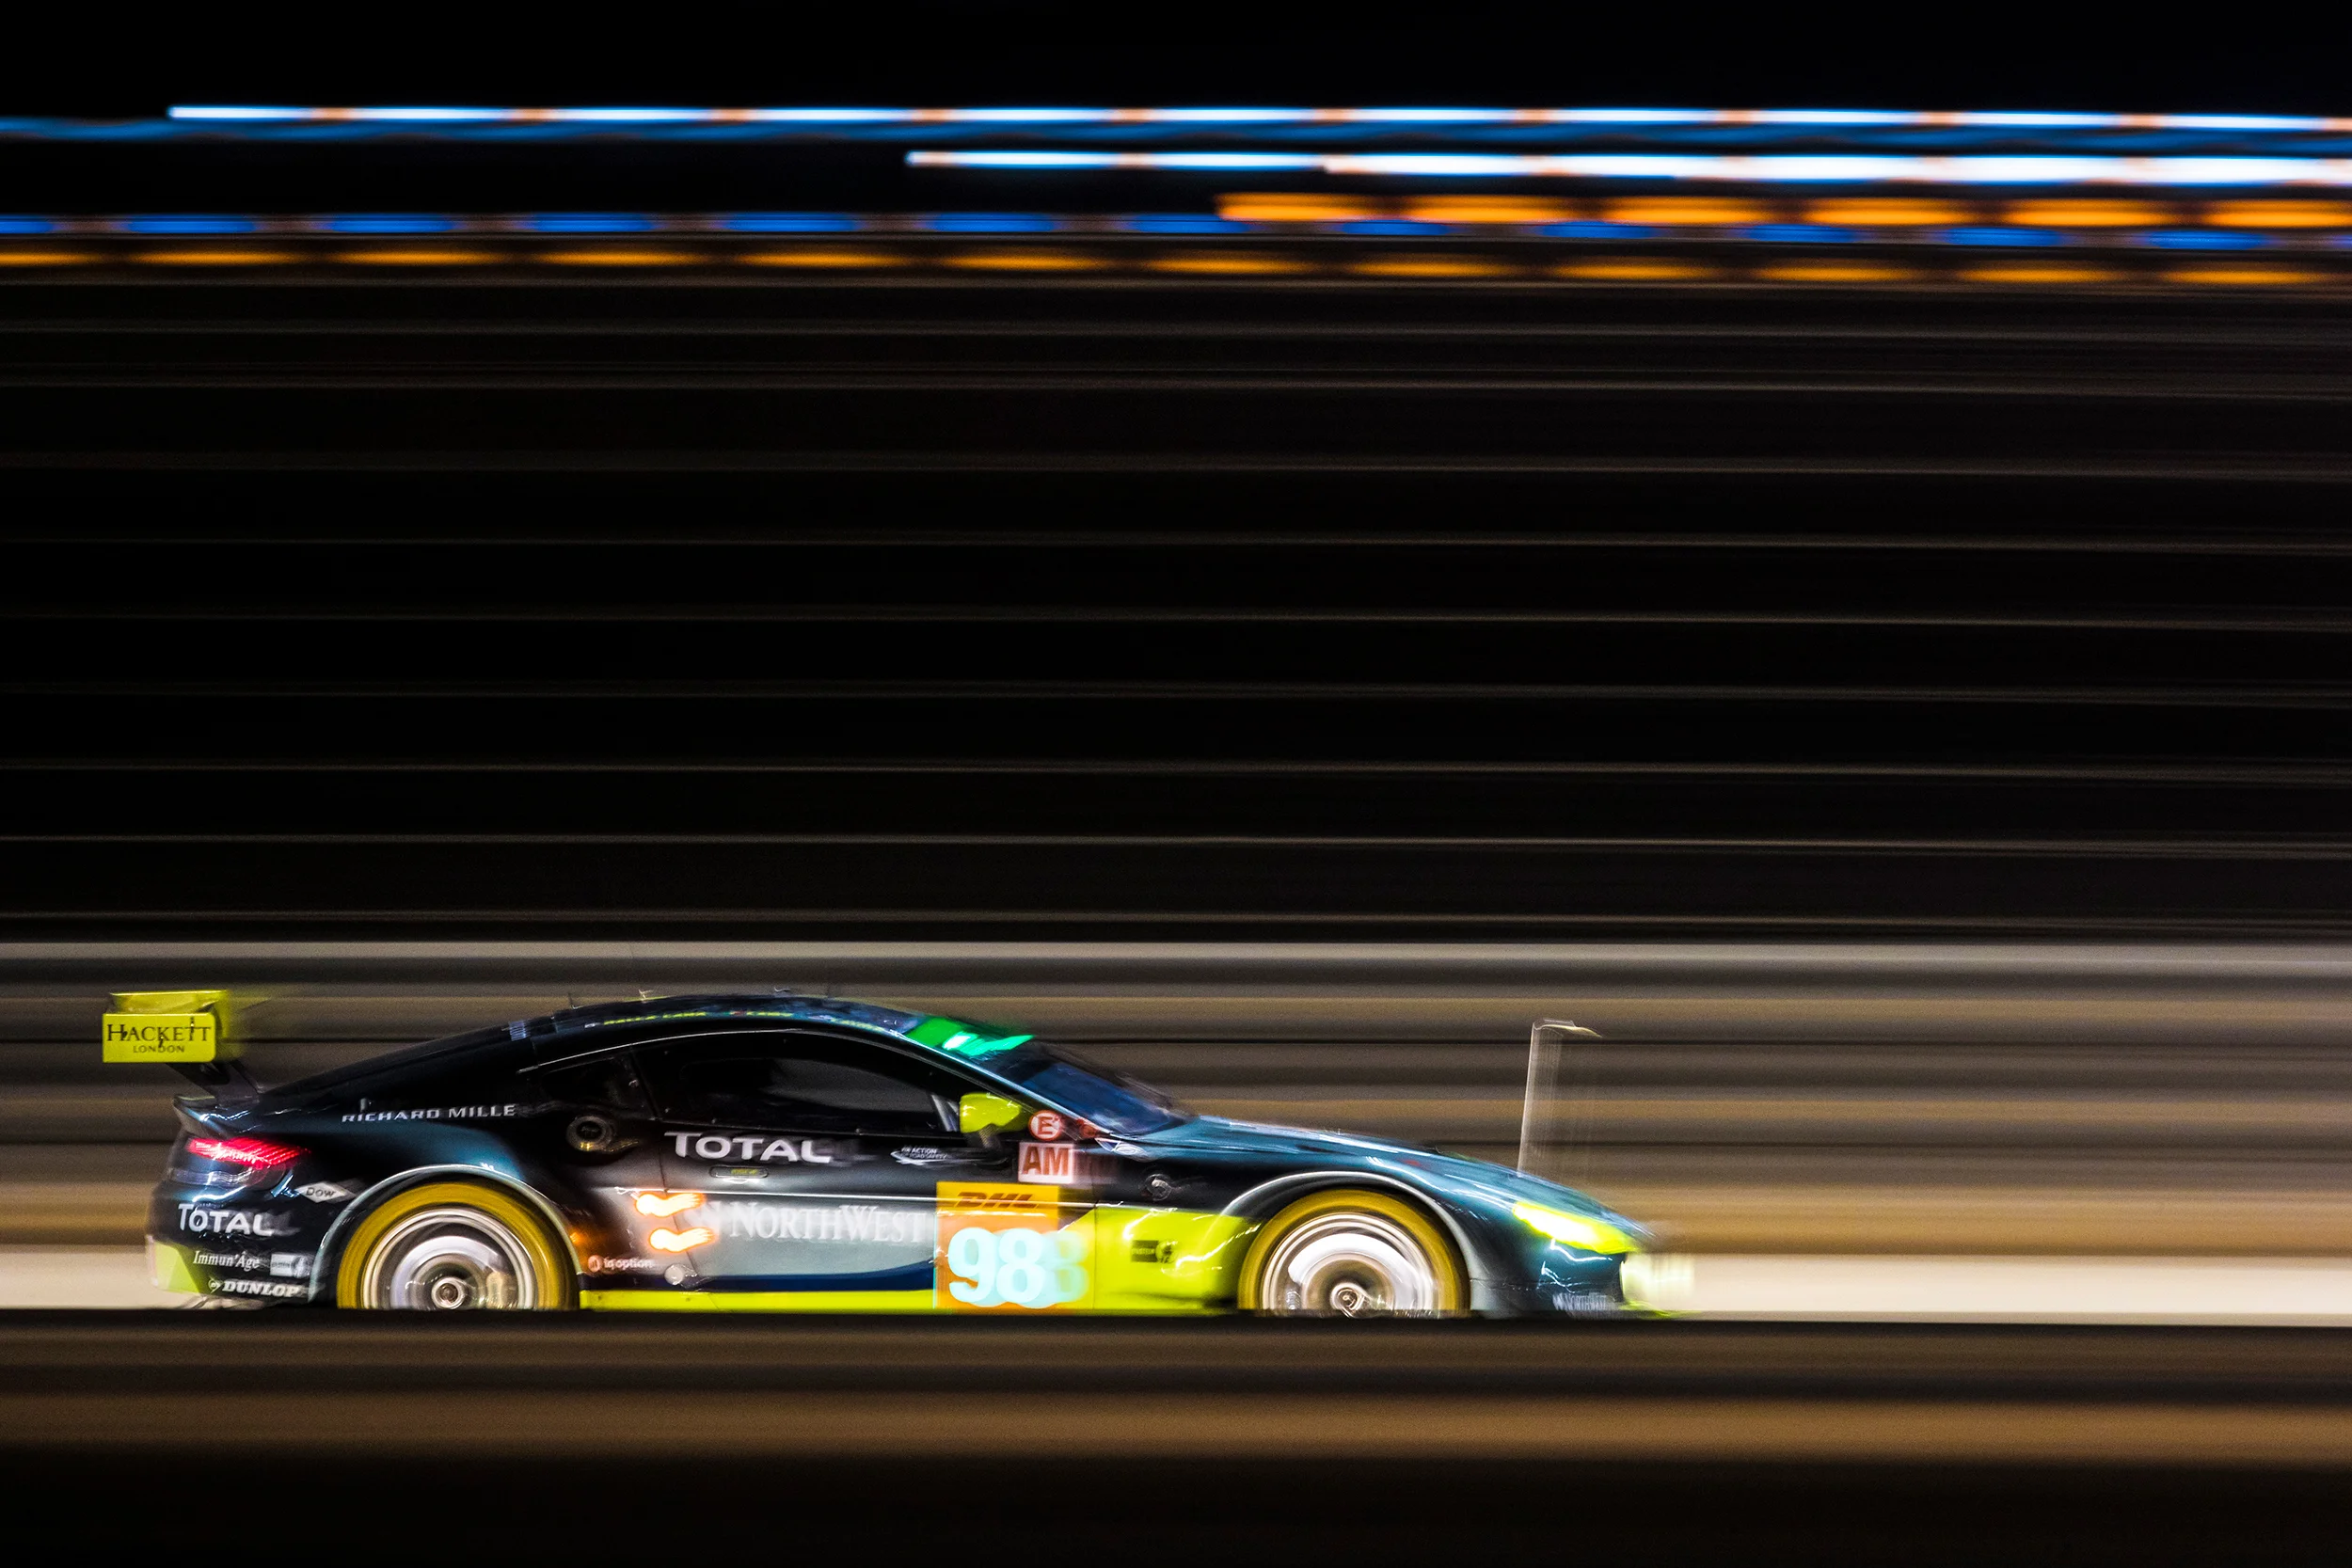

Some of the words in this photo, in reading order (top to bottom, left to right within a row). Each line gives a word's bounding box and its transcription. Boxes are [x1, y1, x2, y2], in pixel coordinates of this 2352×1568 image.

[106, 1023, 212, 1042] HACKETT
[133, 1044, 185, 1053] LONDON
[342, 1110, 440, 1123] RICHARD
[448, 1103, 516, 1118] MILLE
[664, 1132, 832, 1164] TOTAL
[1022, 1145, 1070, 1177] AM
[953, 1192, 1040, 1209] DHL
[178, 1203, 274, 1237] TOTAL
[730, 1201, 928, 1243] NORTHWEST
[947, 1227, 1048, 1305] 98
[222, 1279, 300, 1297] DUNLOP
